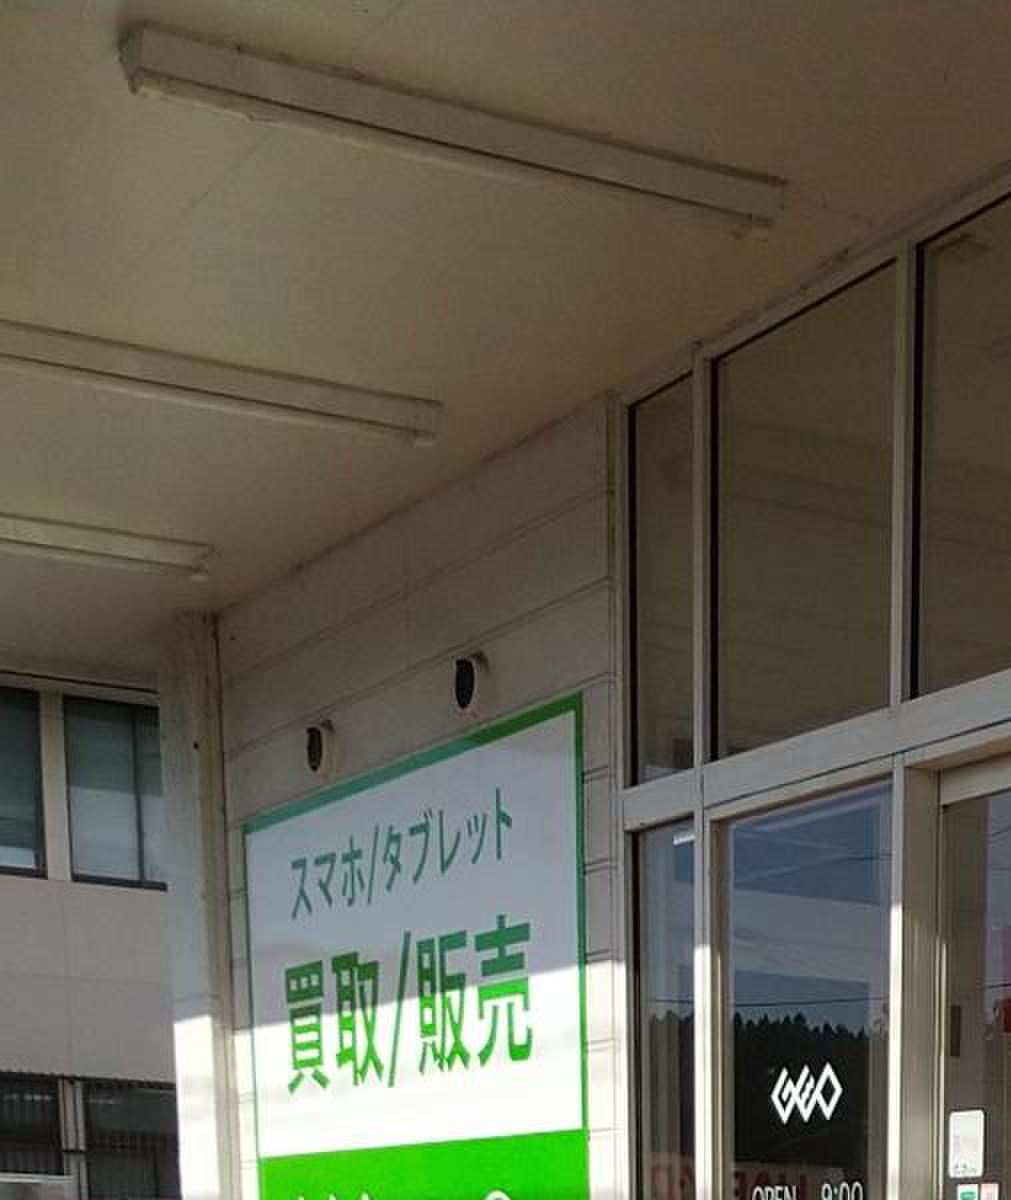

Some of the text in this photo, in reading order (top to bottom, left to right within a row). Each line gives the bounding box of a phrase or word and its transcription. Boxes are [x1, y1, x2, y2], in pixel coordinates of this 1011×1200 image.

[291, 787, 513, 920] スマホ/タブレット
[284, 914, 533, 1094] 買取/販売
[770, 1062, 843, 1124] GEO
